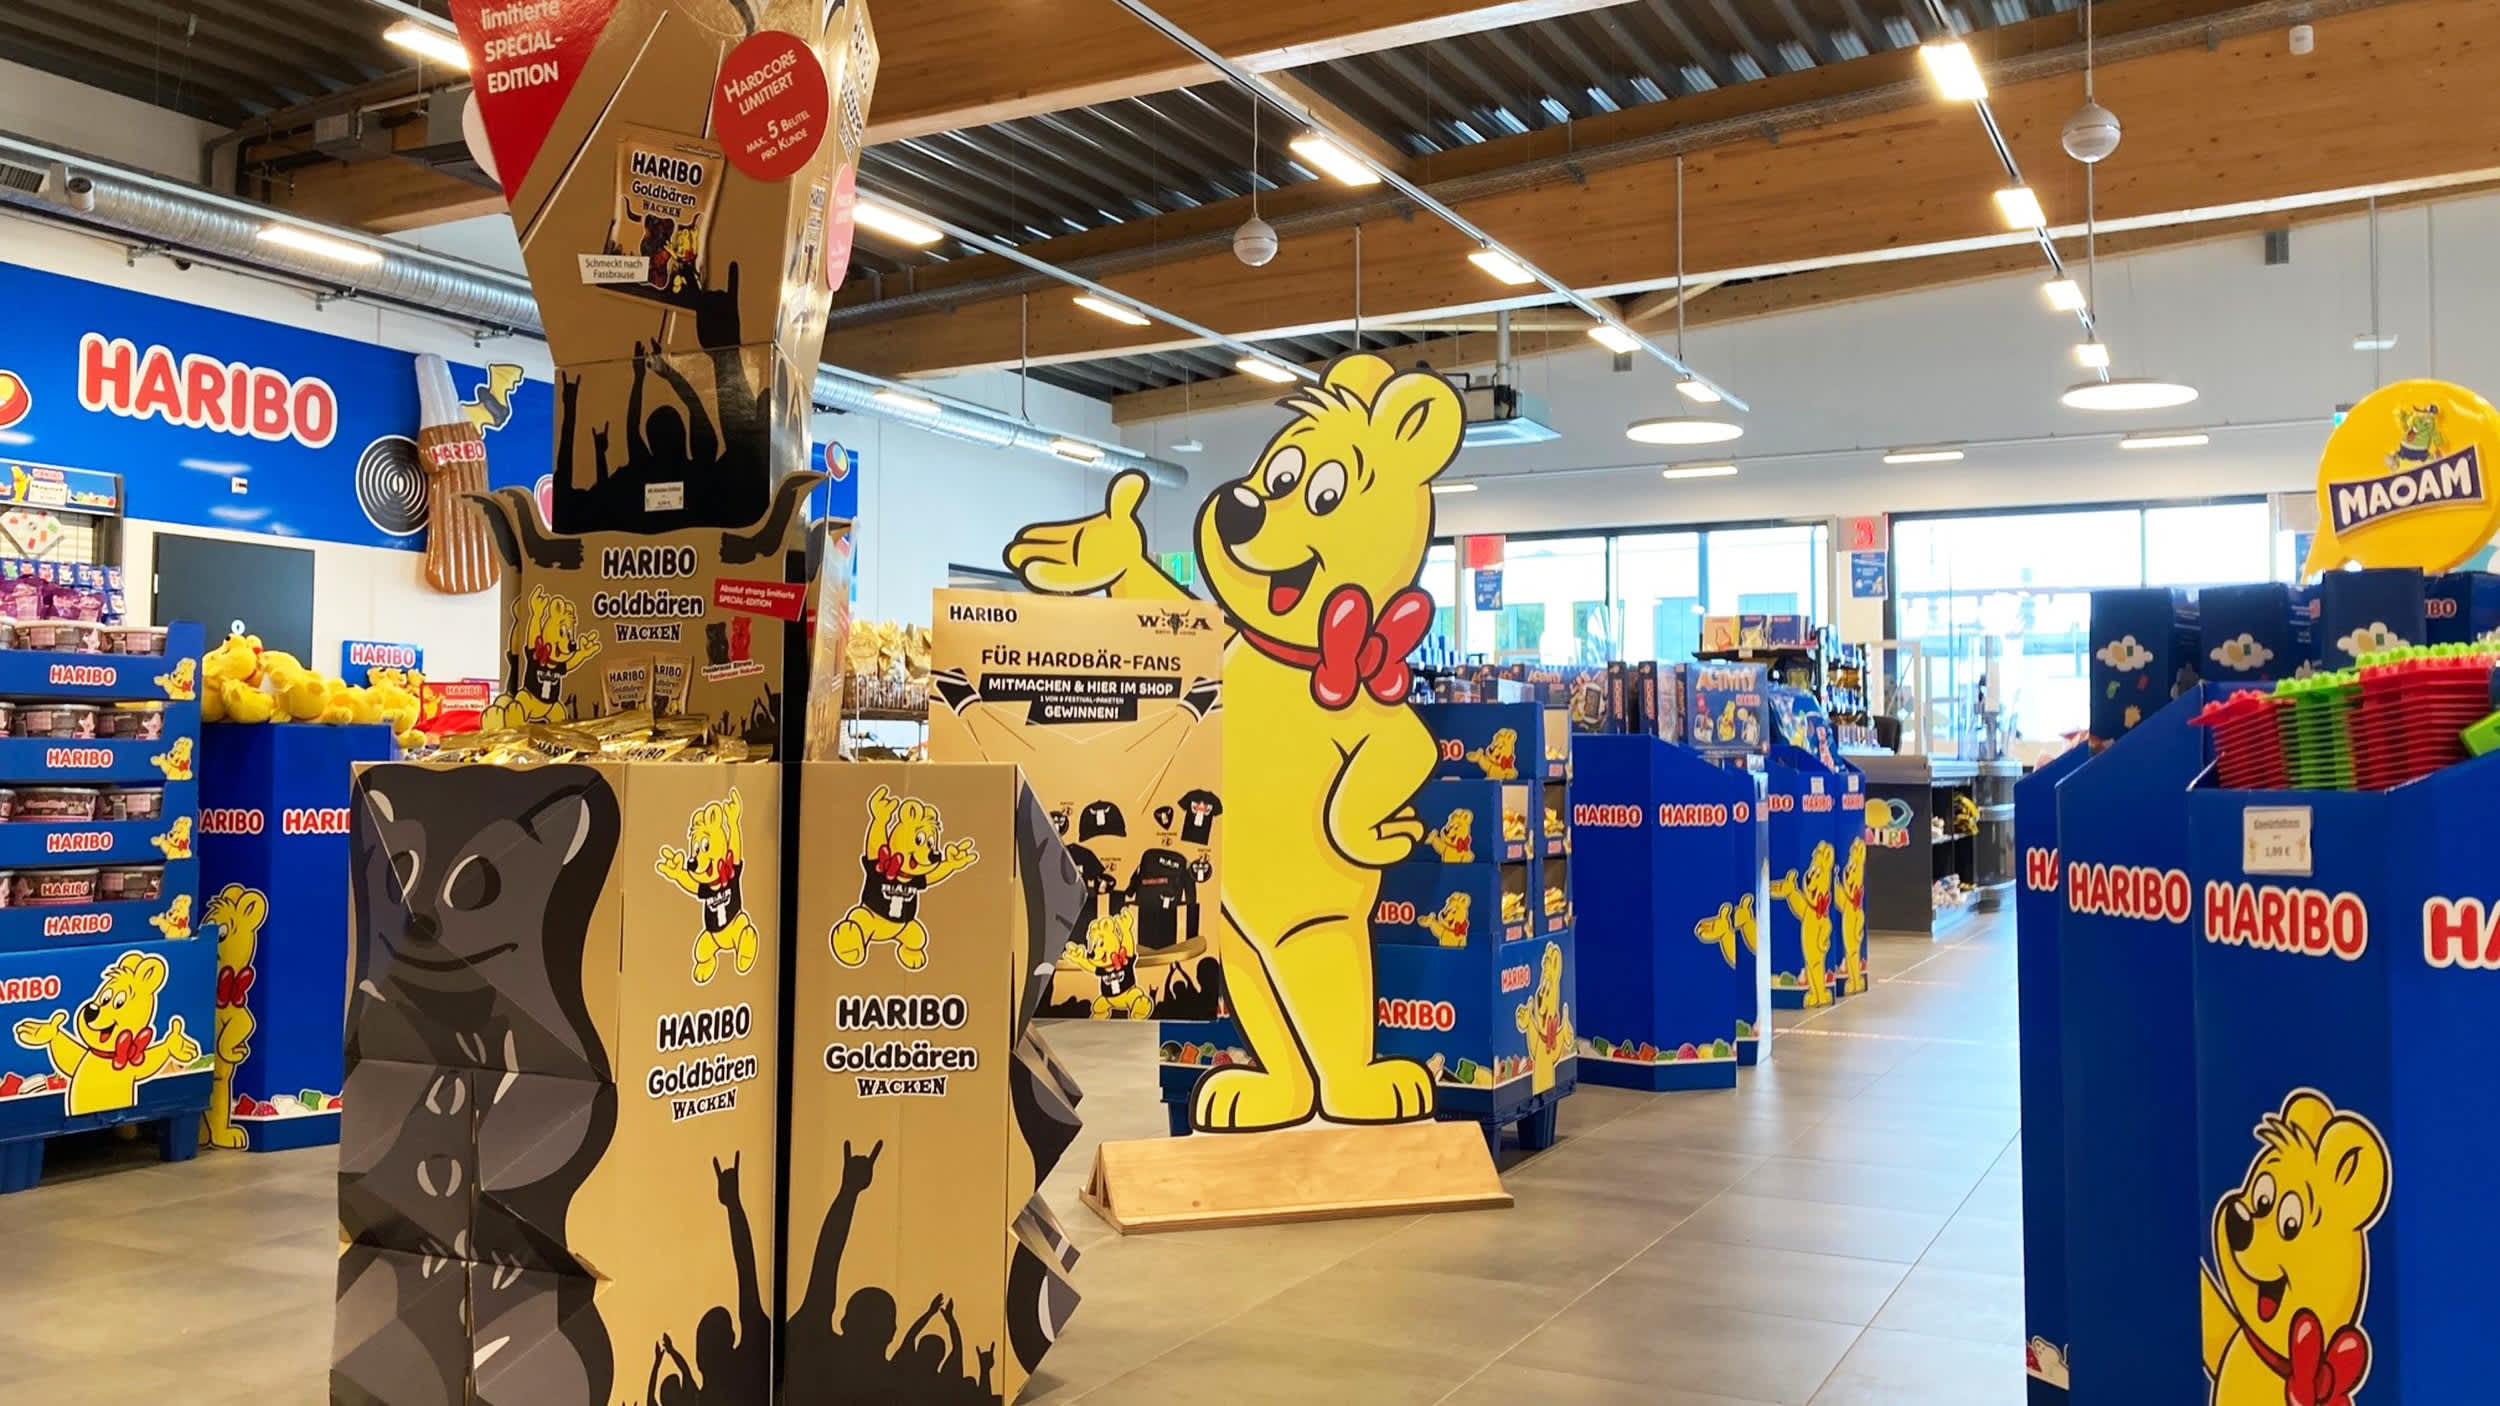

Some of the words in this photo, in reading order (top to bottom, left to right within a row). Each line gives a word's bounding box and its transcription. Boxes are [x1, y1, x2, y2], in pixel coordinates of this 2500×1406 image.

[481, 0, 561, 31] limitierte
[484, 29, 564, 62] SPECIAL-
[487, 60, 560, 94] EDITION
[723, 49, 798, 103] HARDCORE
[738, 71, 795, 116] LIMITIERT
[767, 119, 779, 139] 5
[632, 151, 703, 186] HARIBO
[632, 180, 696, 206] Goldbären
[642, 199, 682, 218] WACKEN
[82, 335, 336, 446] HARIBO
[2338, 456, 2473, 526] MAOAM
[603, 547, 696, 578] HARIBO
[594, 590, 703, 617] Goldbären
[948, 605, 1018, 623] HARIBO
[616, 623, 681, 642] WACKEN
[352, 643, 415, 667] HARIBO
[981, 644, 1021, 666] FÜR
[1027, 649, 1182, 672] HARDBÄR-FANS
[50, 664, 116, 687] HARIBO
[609, 670, 645, 683] HARIBO
[654, 665, 682, 678] ARIBO
[988, 678, 1071, 693] MITMACHEN
[1074, 680, 1084, 693] &
[1087, 681, 1117, 694] HIER
[1120, 682, 1136, 694] IM
[1139, 682, 1174, 696] SHOP
[1044, 705, 1119, 720] GEWINNEN!
[47, 748, 113, 768] HARIBO
[198, 810, 264, 835] ARIBO
[283, 809, 350, 835] HARI
[1574, 804, 1642, 827] HARIBO
[1659, 803, 1727, 827] HARIBO
[47, 831, 113, 852] HARIBO
[41, 881, 89, 896] HARIBO
[2069, 862, 2192, 923] HARIBO
[44, 913, 112, 936] HARIBO
[1375, 900, 1415, 924] IBO
[2206, 881, 2368, 961] HARIBO
[1501, 965, 1531, 994] HARIBO
[837, 996, 967, 1030] HARIBO
[1377, 999, 1455, 1030] ARIBO
[658, 1004, 752, 1051] HARIBO
[825, 1043, 977, 1071] Goldbären
[647, 1055, 757, 1096] Goldbären
[857, 1076, 947, 1096] WACKEN
[672, 1090, 737, 1122] WACKEN
